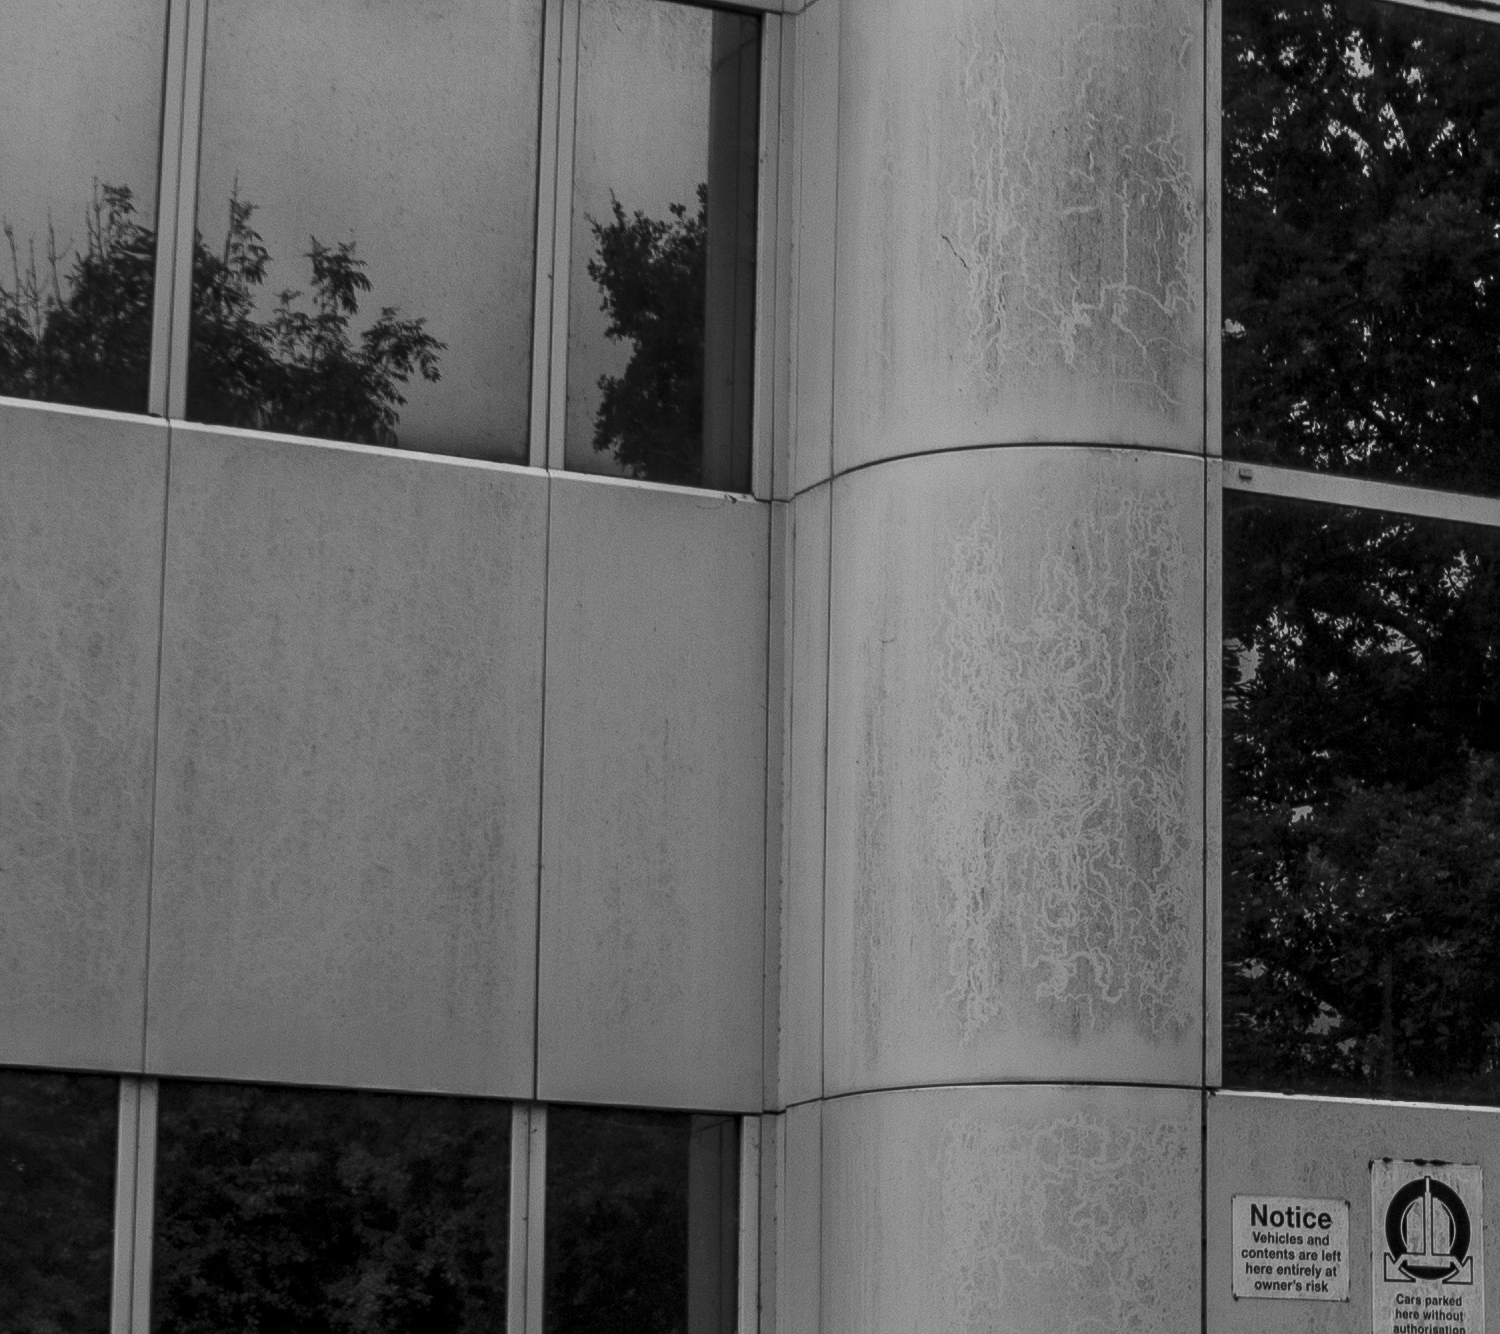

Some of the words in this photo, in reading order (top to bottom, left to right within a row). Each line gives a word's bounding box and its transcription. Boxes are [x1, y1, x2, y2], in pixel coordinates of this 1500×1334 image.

[1250, 1203, 1332, 1230] Notice
[1252, 1230, 1304, 1245] Vehicles
[1307, 1234, 1330, 1246] and
[1241, 1247, 1296, 1261] contents
[1298, 1251, 1318, 1261] are
[1321, 1249, 1342, 1262] left
[1245, 1262, 1273, 1275] here
[1276, 1263, 1321, 1279] entirely
[1325, 1266, 1337, 1277] at
[1254, 1279, 1303, 1292] owner's
[1305, 1280, 1329, 1293] risk
[1396, 1293, 1422, 1306] Cars
[1425, 1294, 1463, 1309] parked
[1395, 1308, 1420, 1321] here
[1423, 1310, 1464, 1323] without
